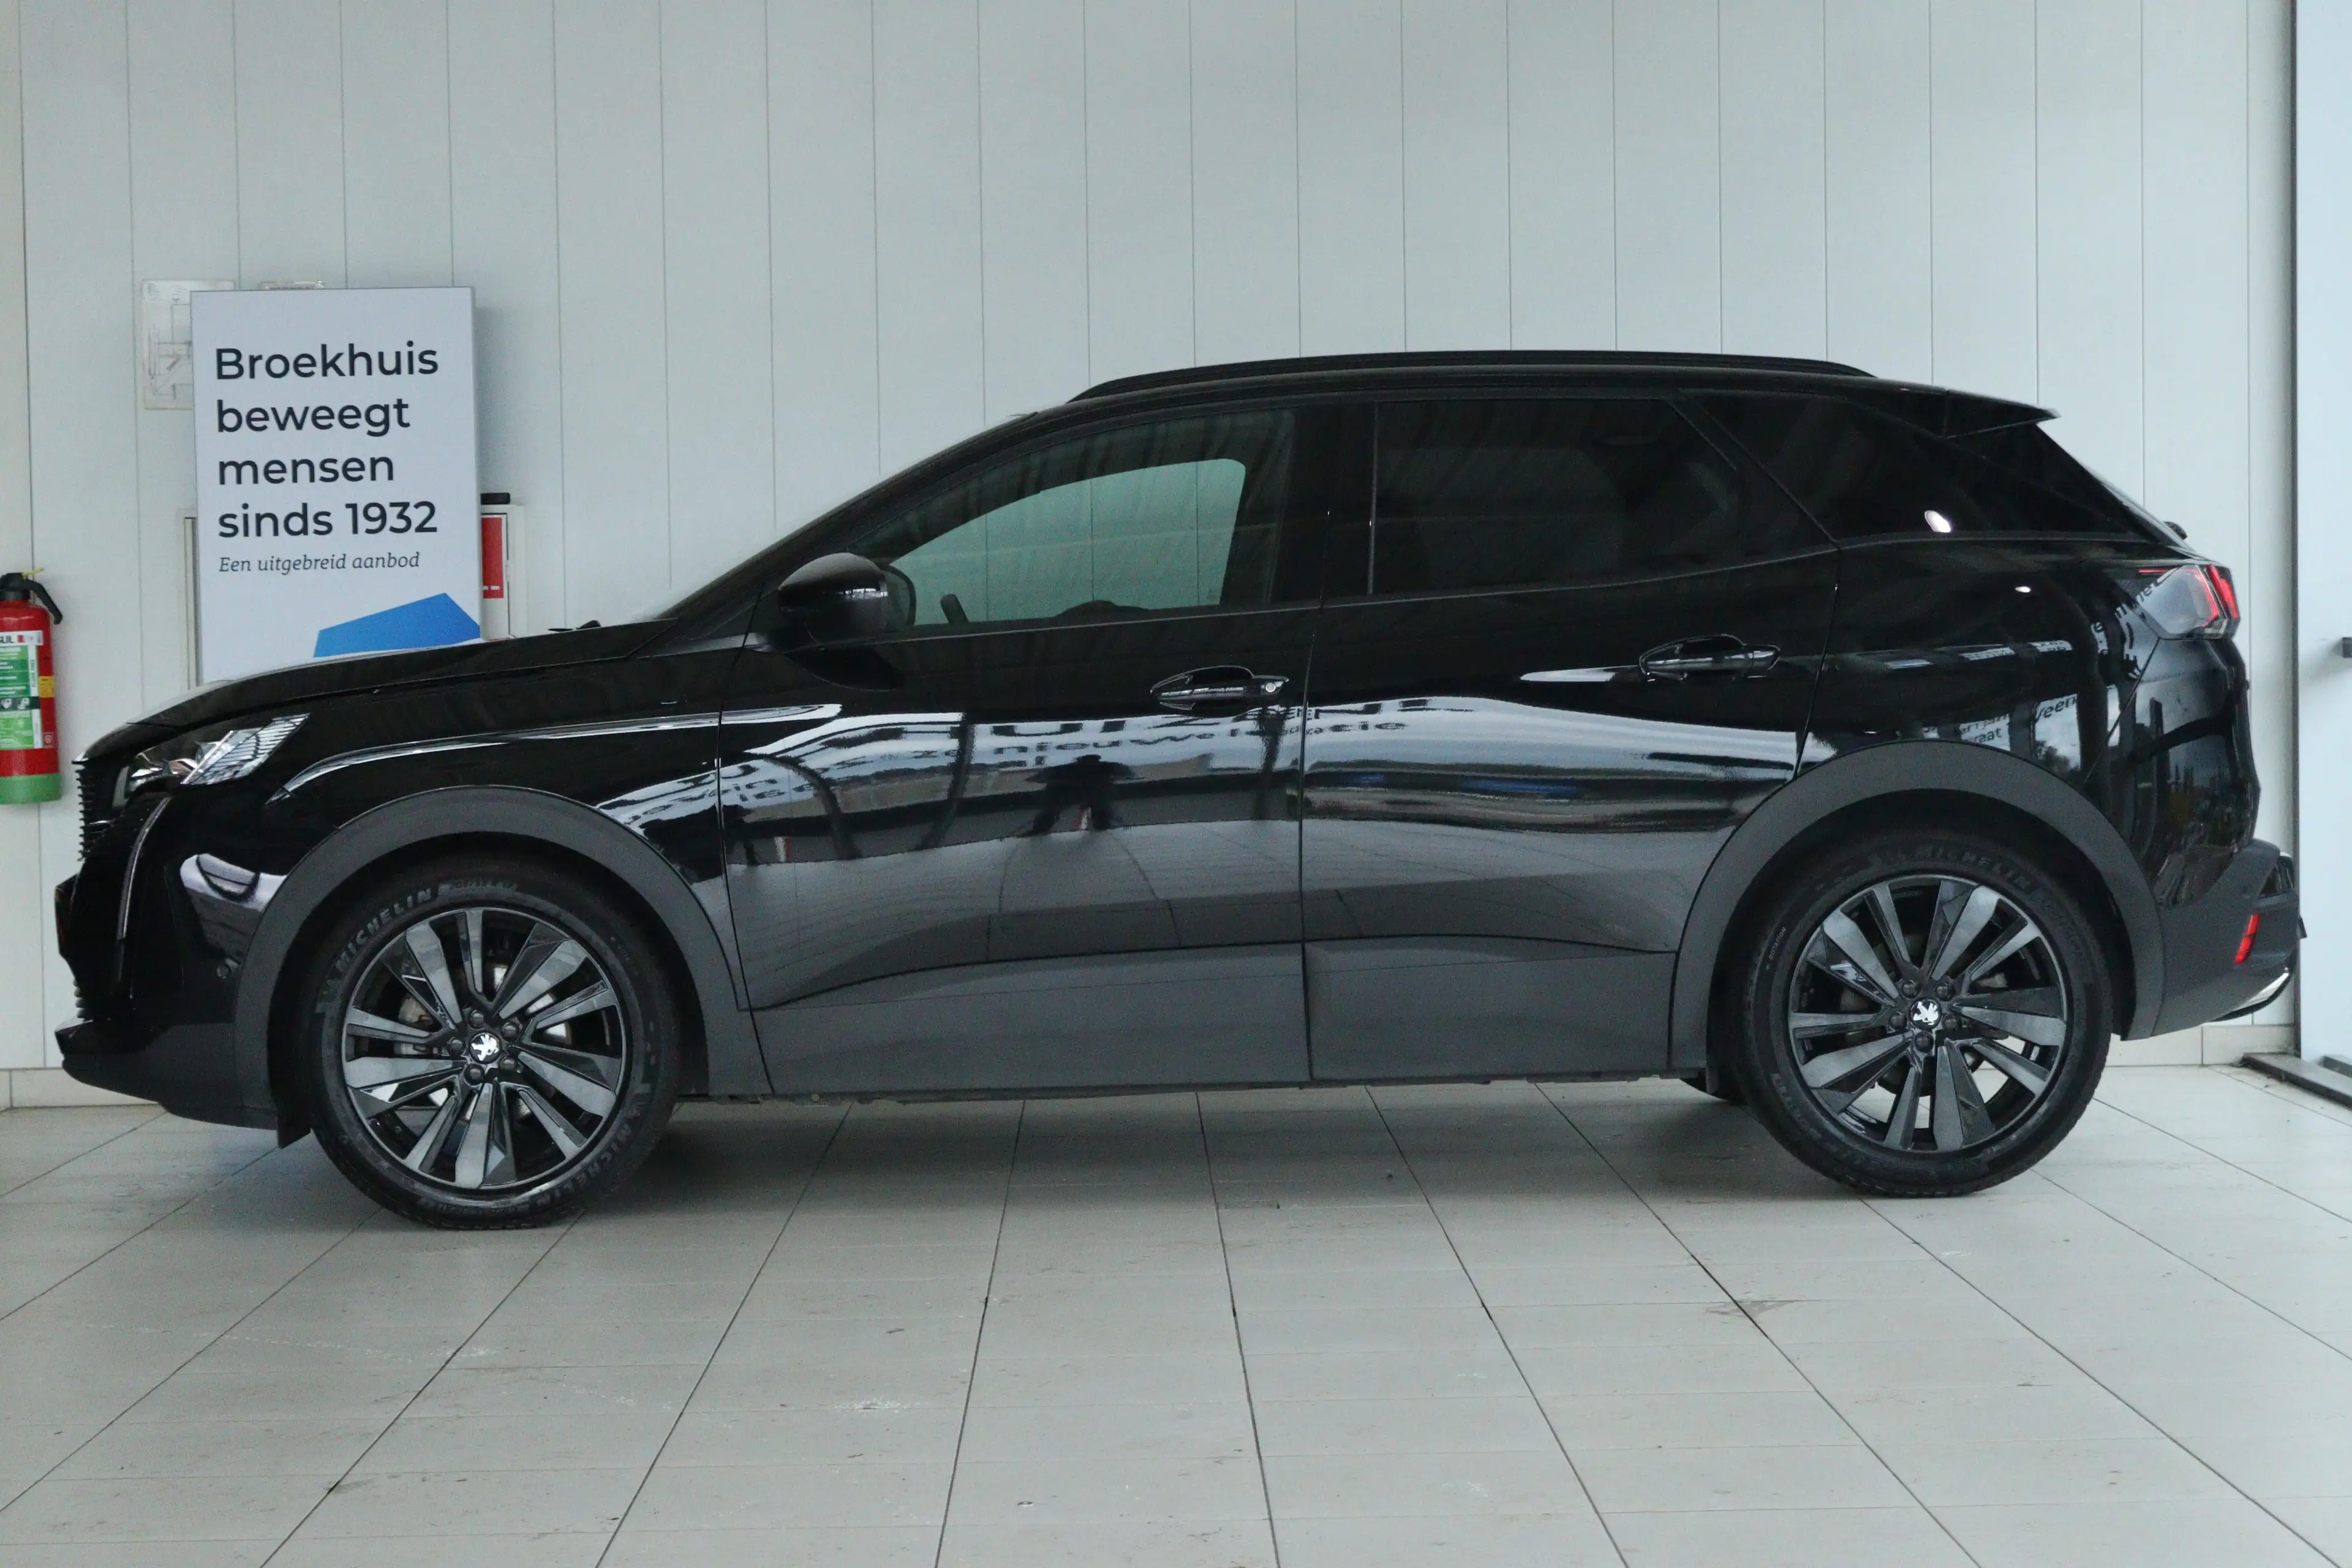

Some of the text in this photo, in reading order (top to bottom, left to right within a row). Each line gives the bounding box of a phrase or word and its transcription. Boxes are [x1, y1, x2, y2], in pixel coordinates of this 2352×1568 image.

[216, 340, 439, 380] Broekhuis
[217, 398, 411, 437] beweegt
[219, 456, 394, 485] mensen
[219, 500, 437, 538] sinds 1932
[219, 551, 420, 575] Een uitgebreid aanbod
[336, 888, 431, 973] MICHELIN
